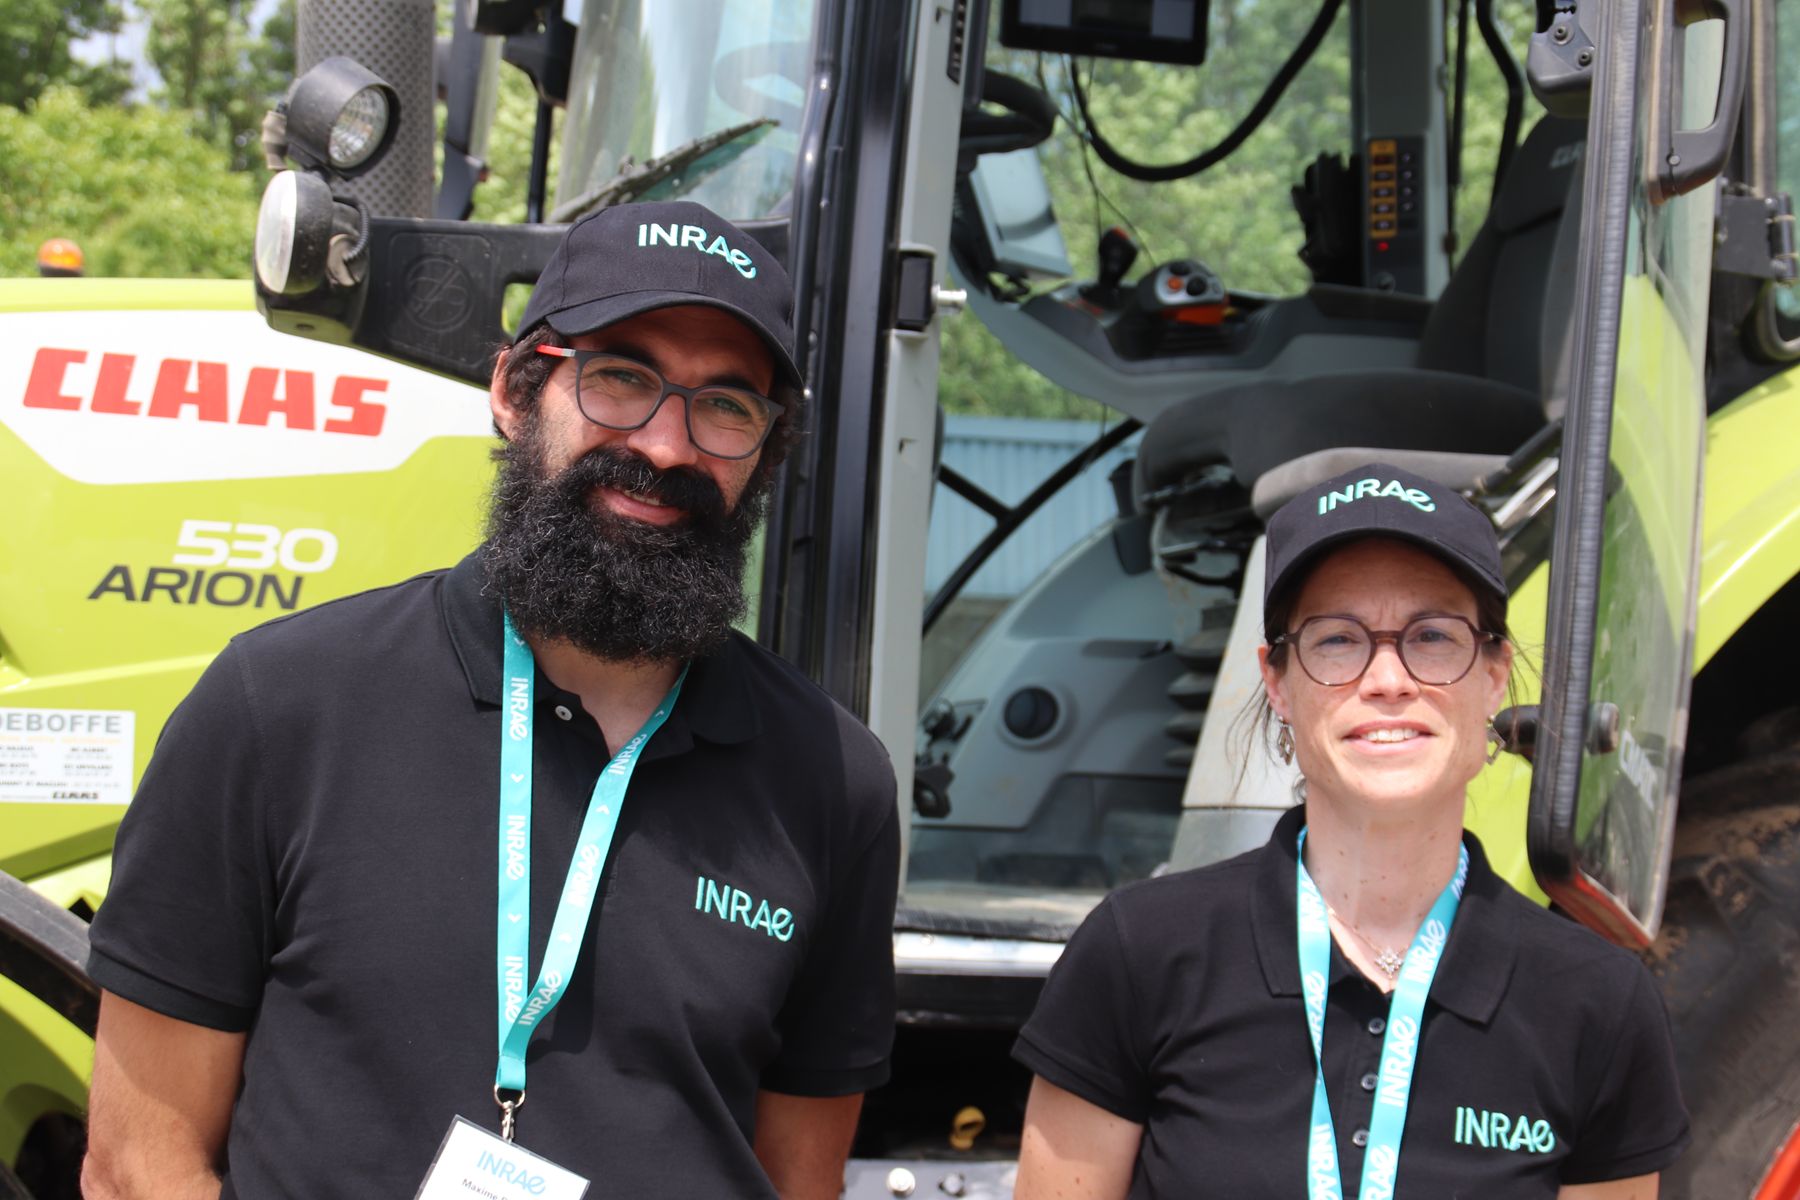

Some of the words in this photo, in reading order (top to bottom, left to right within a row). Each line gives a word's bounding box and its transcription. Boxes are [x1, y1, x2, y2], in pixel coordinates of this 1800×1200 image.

[23, 347, 390, 437] CLAAS
[173, 519, 338, 573] 530
[88, 565, 304, 609] ARION
[0, 712, 121, 734] EBOFFE
[461, 1178, 498, 1200] Maxime
